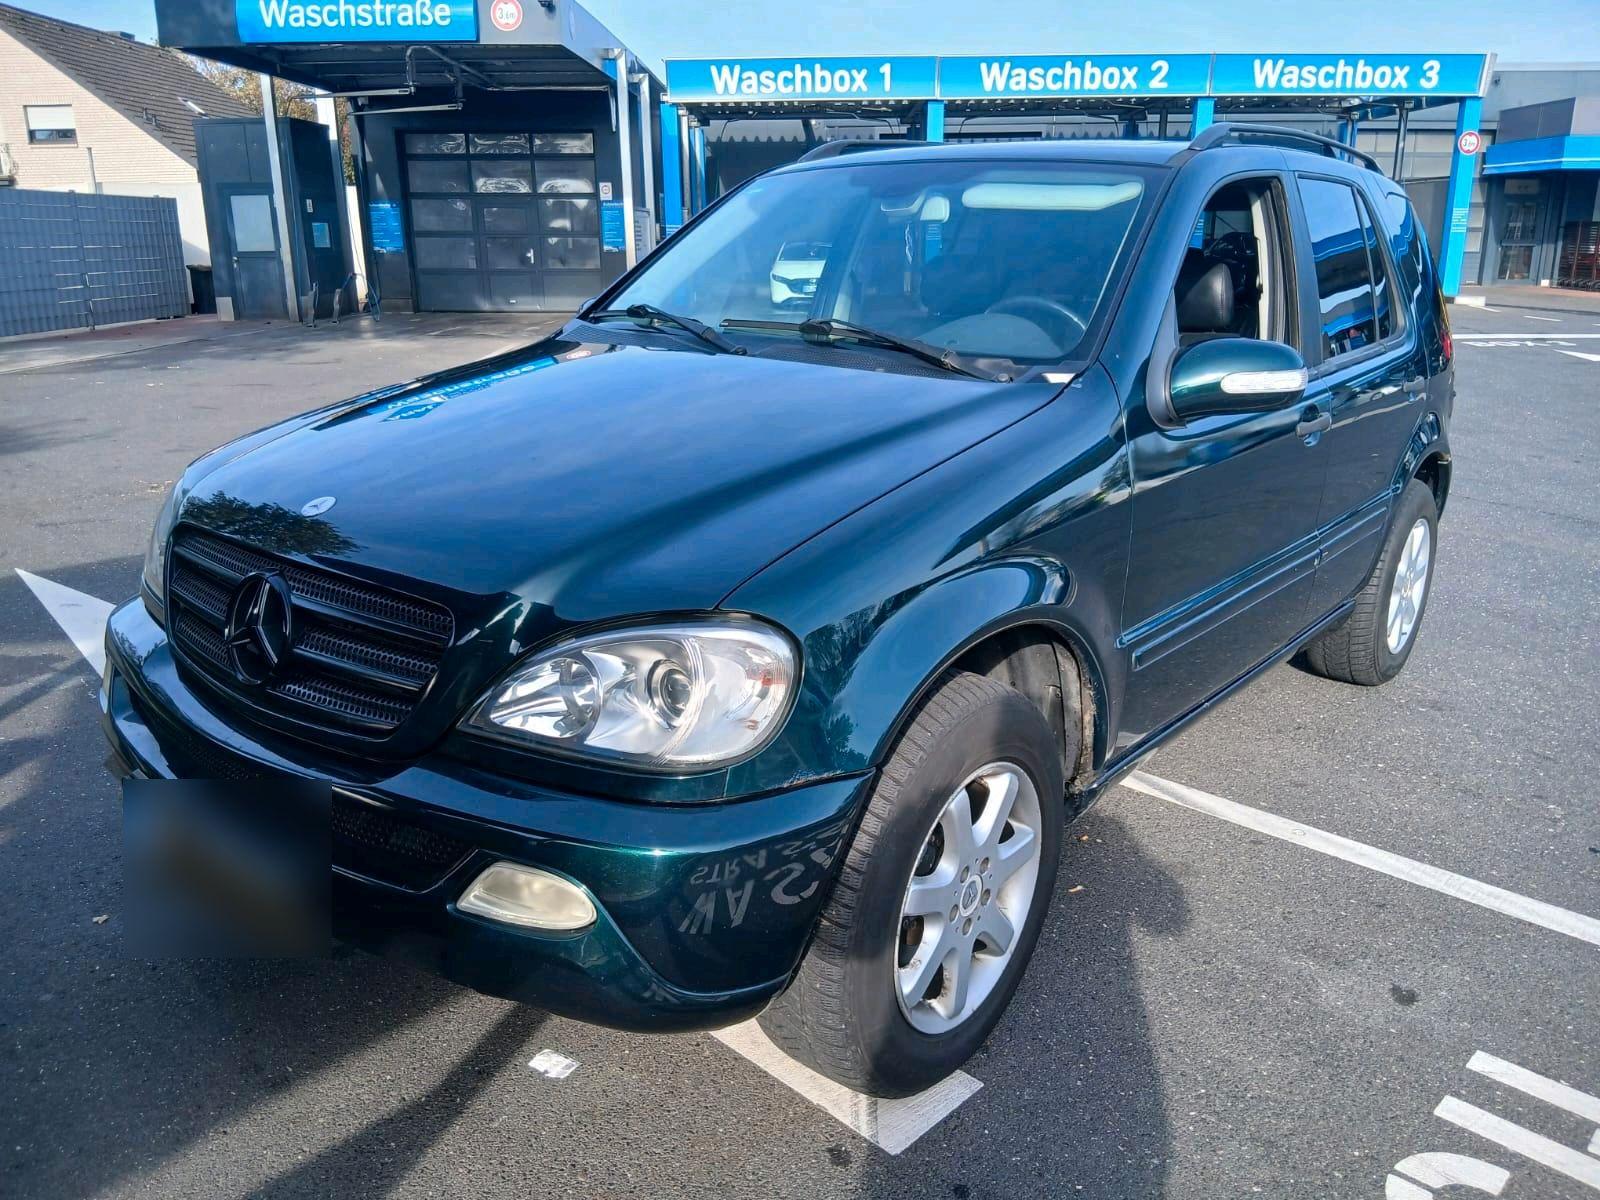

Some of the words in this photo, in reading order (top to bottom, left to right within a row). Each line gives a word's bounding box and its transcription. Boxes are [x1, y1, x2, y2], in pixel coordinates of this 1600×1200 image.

[259, 0, 451, 28] Waschstraße
[710, 63, 868, 95] Waschbox
[879, 62, 892, 92] 1
[980, 60, 1139, 92] Waschbox
[1148, 60, 1169, 89] 2
[1253, 58, 1410, 89] Waschbox
[1419, 59, 1441, 89] 3
